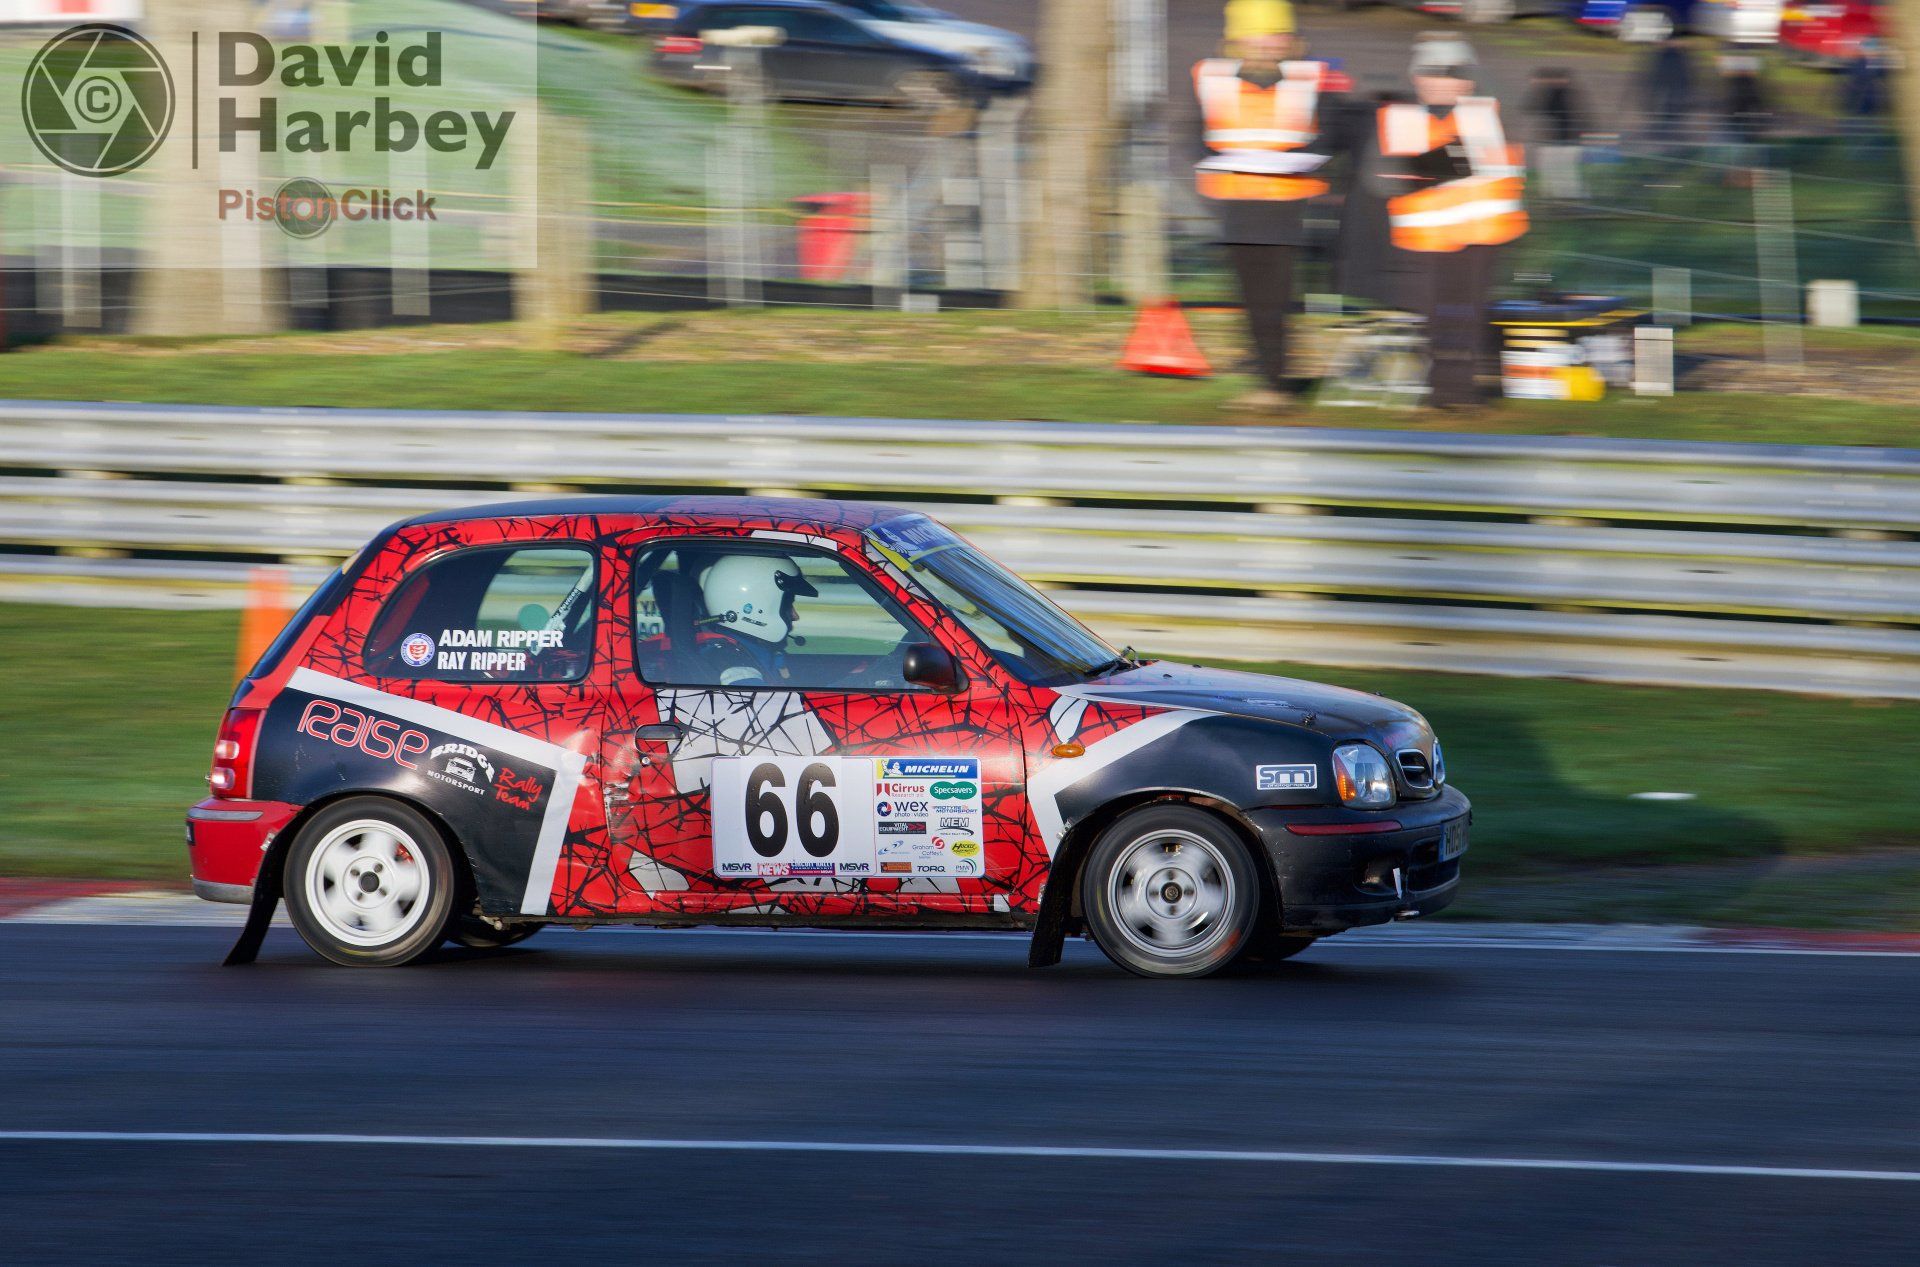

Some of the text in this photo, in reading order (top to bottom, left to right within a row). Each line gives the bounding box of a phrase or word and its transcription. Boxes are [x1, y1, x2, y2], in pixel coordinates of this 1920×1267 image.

[438, 629, 564, 649] ADAM RIPPER
[437, 651, 527, 672] RAY RIPPER
[430, 743, 495, 783] BRIDGE
[904, 765, 969, 774] MICHELIN
[427, 770, 486, 796] MOTORSPORT
[498, 766, 543, 803] Rally
[892, 783, 925, 793] Cirrus
[934, 786, 973, 795] Specsavers
[493, 783, 531, 811] Team
[745, 762, 840, 858] 66
[894, 801, 929, 812] wex
[940, 817, 970, 828] MEM
[722, 862, 752, 871] MSVR
[758, 863, 791, 876] NEWS
[839, 862, 870, 871] MSVR
[917, 865, 946, 873] TORQ
